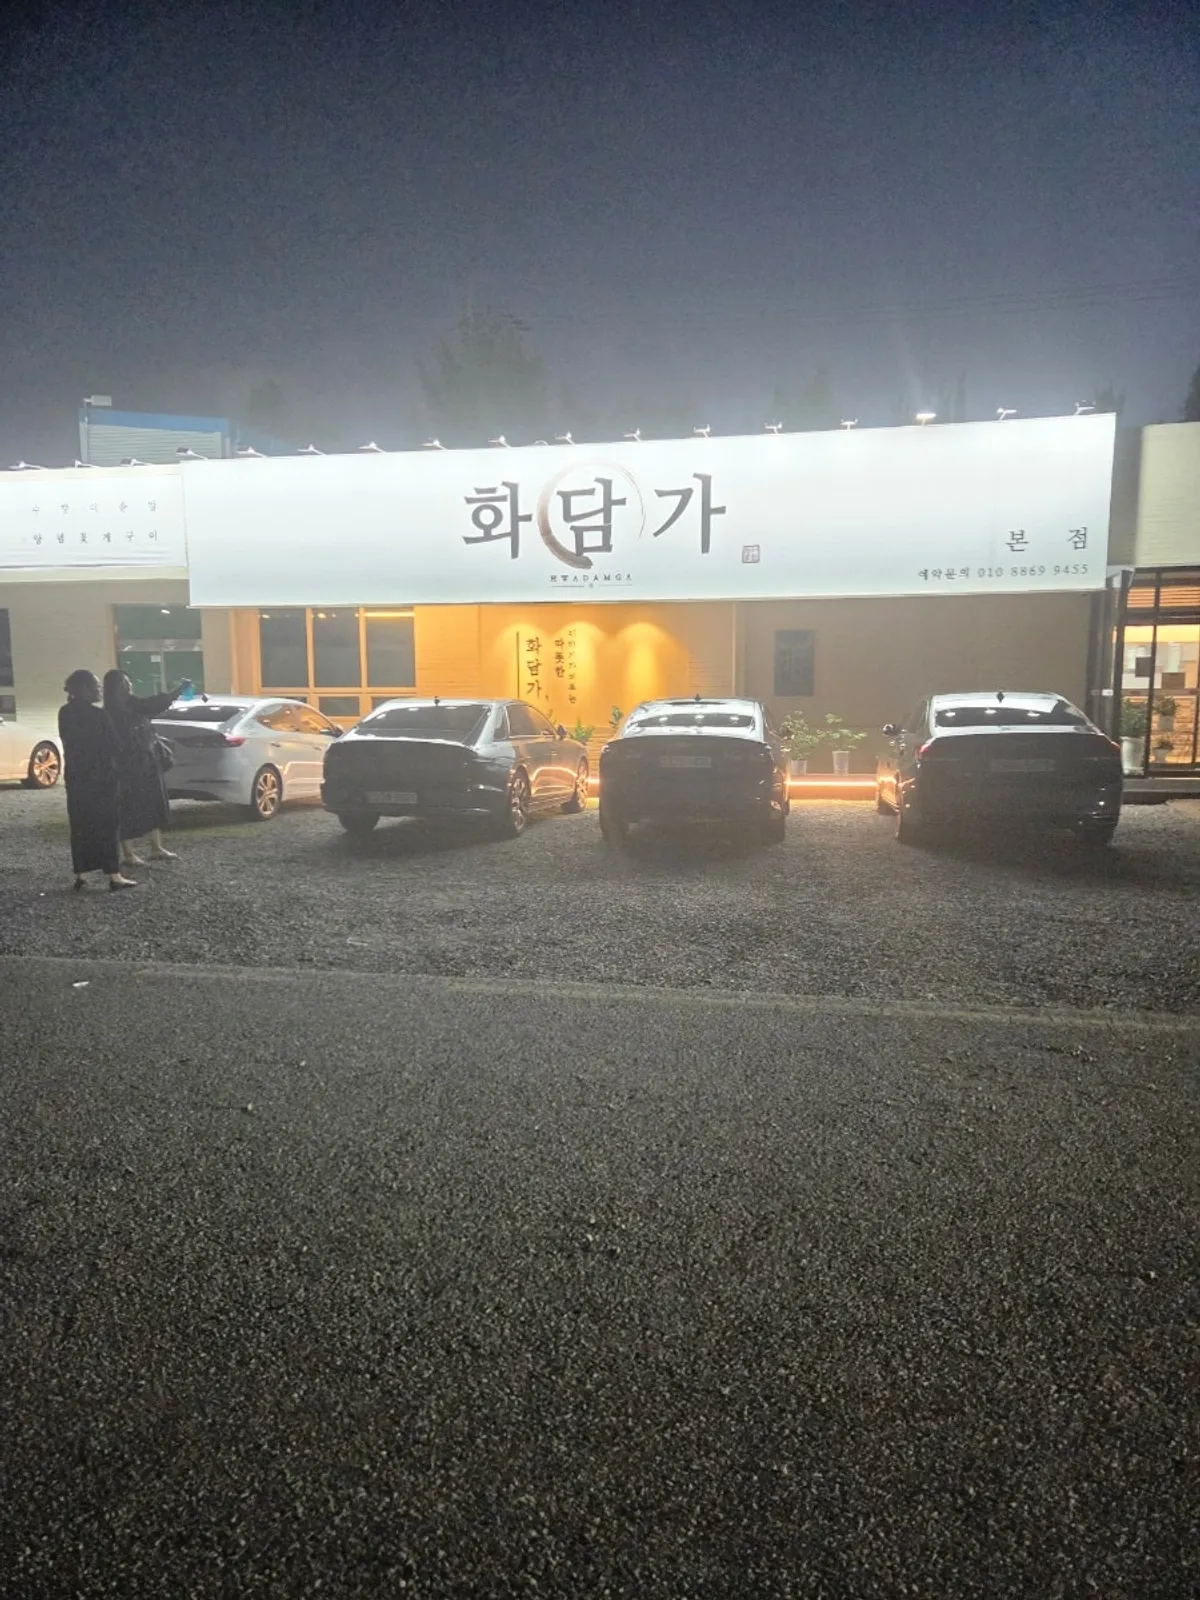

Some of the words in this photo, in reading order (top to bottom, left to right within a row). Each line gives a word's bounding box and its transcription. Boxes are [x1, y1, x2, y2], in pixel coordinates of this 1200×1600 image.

[462, 472, 727, 559] 화담가
[549, 573, 633, 582] HWADAMGA
[917, 566, 971, 581] 예약문의
[976, 567, 1004, 579] 010
[1010, 565, 1046, 577] 8869
[1051, 563, 1089, 576] 9455
[526, 636, 543, 699] 화담가
